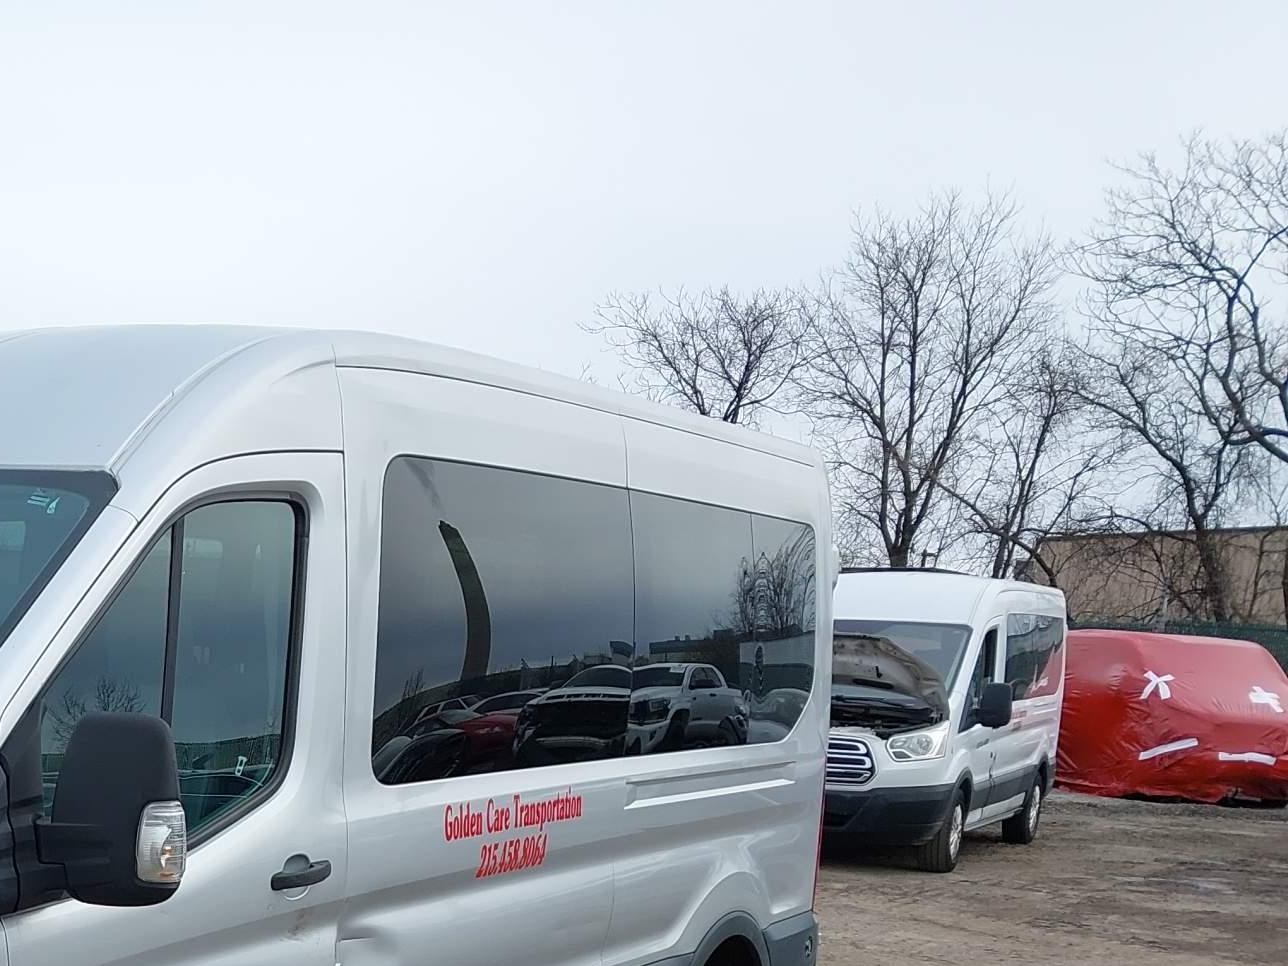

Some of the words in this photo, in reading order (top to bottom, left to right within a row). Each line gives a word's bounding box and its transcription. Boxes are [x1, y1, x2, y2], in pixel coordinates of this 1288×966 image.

[445, 802, 482, 841] Golden
[487, 798, 511, 833] Care
[514, 786, 582, 832] Transportation
[476, 834, 548, 878] 215.458.8064
